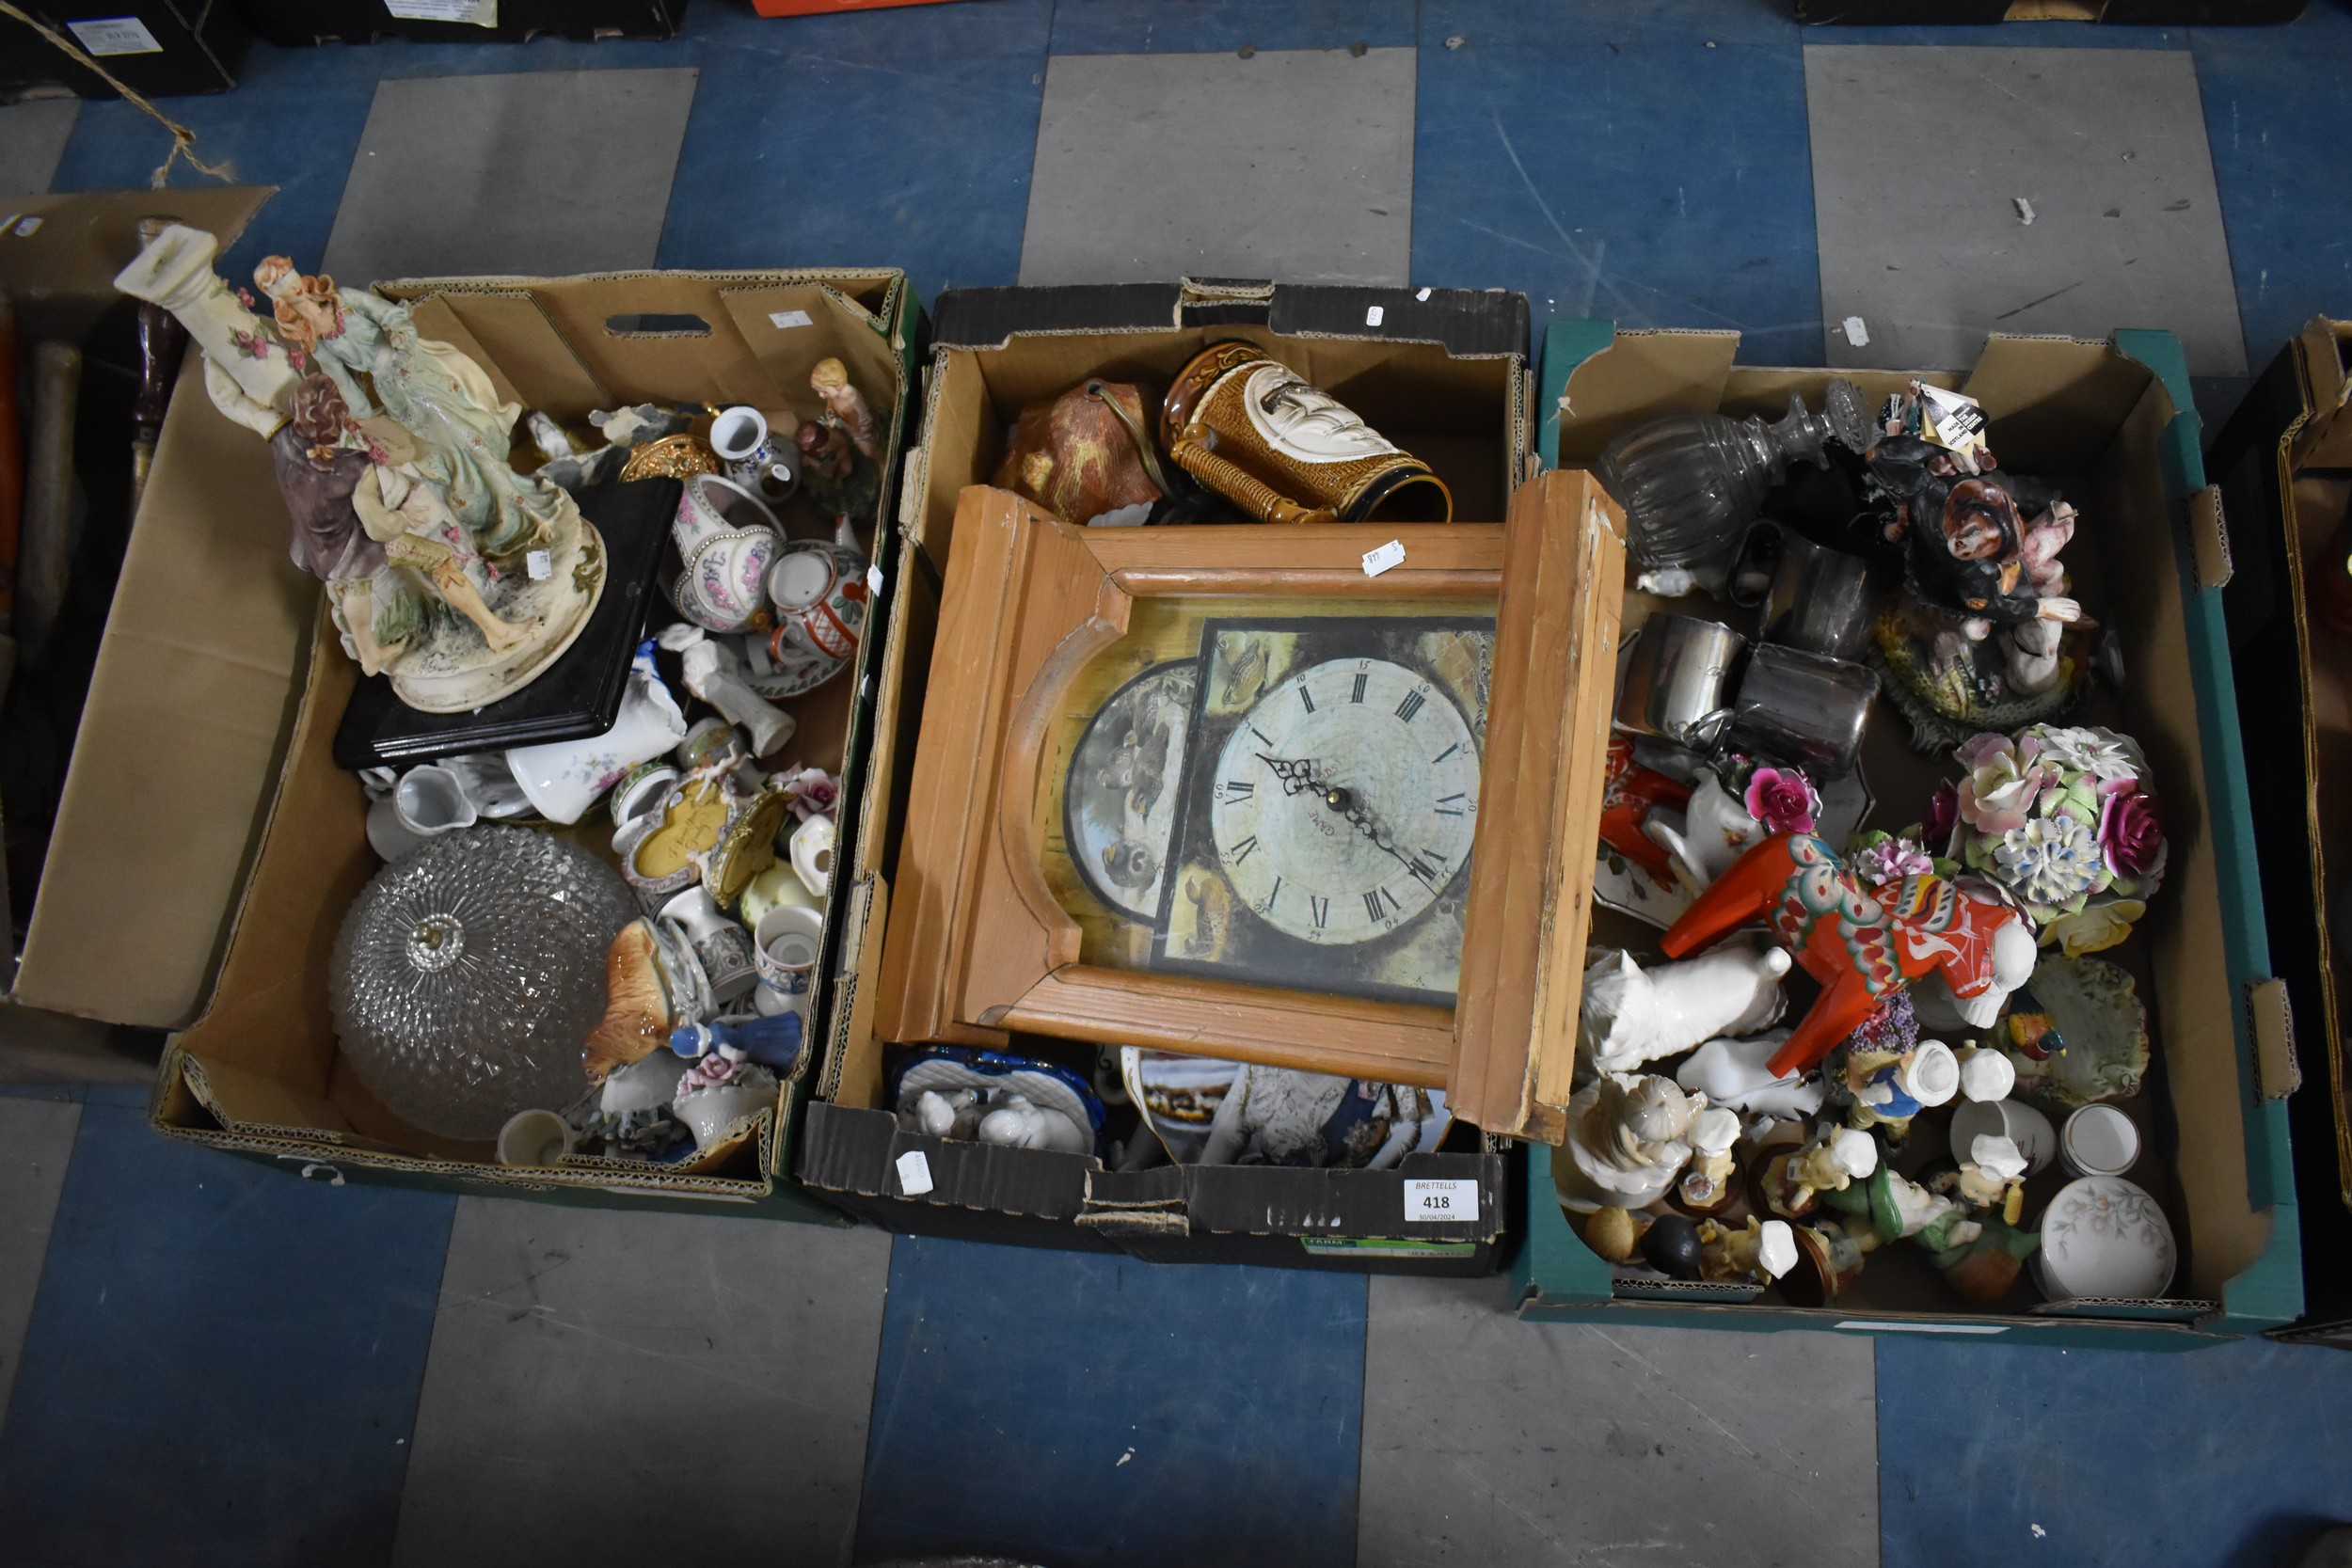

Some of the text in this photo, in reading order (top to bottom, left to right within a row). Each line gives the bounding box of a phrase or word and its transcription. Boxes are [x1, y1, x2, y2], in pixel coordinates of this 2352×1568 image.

[1947, 421, 1960, 432] MADE
[1948, 430, 1968, 446] SCOTLAND
[1359, 660, 1371, 670] 15
[1296, 673, 1306, 684] 10
[1349, 673, 1368, 704] III
[1299, 685, 1316, 714] II
[1215, 784, 1224, 800] 60
[1224, 781, 1255, 809] XII
[1434, 792, 1465, 816] VI
[1309, 809, 1335, 836] GAME
[1220, 851, 1232, 867] 55
[1261, 875, 1290, 909] X
[1363, 885, 1402, 923] VIII
[1415, 1181, 1457, 1190] BRETTELLS
[1422, 1196, 1450, 1209] 418
